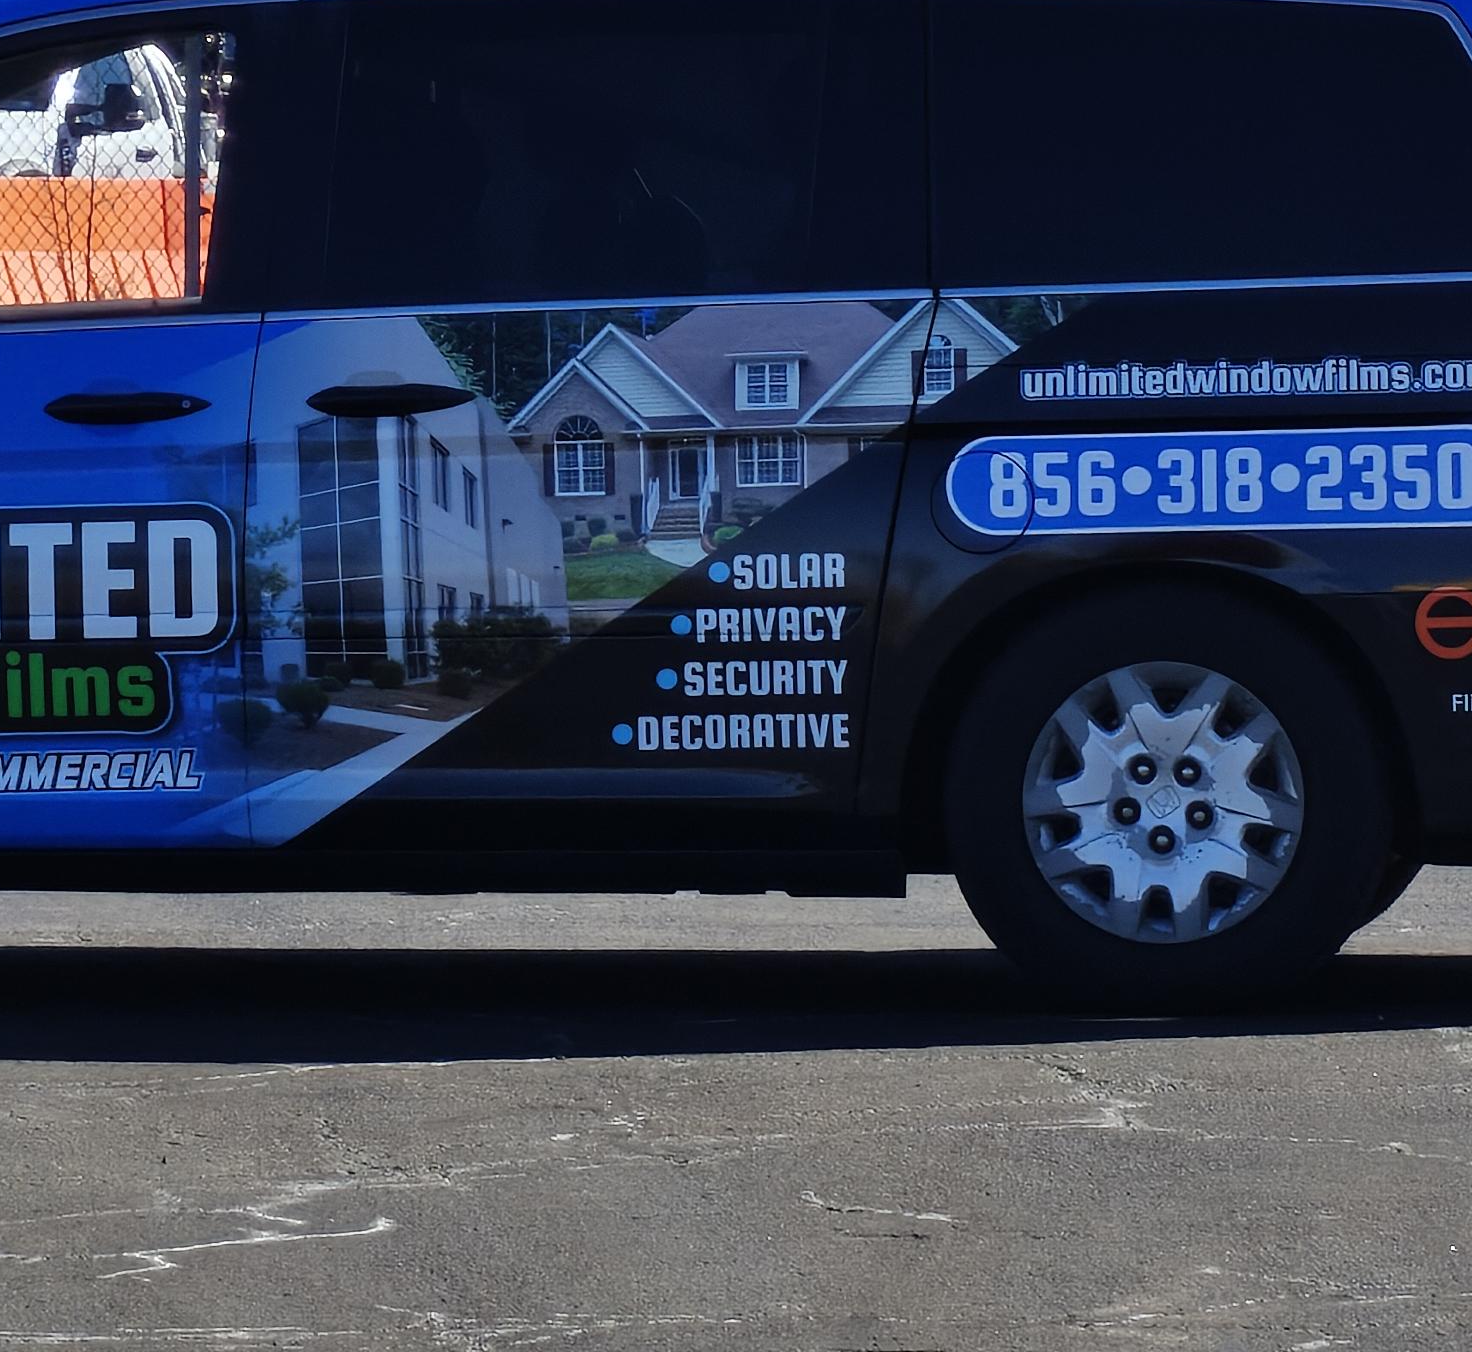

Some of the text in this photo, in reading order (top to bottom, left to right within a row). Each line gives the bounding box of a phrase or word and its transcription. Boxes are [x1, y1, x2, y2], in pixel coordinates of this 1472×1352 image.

[733, 553, 846, 591] SOLAR
[696, 605, 847, 643] PRIVACY
[684, 659, 849, 698] SECURITY
[637, 712, 851, 752] DECORATIVE
